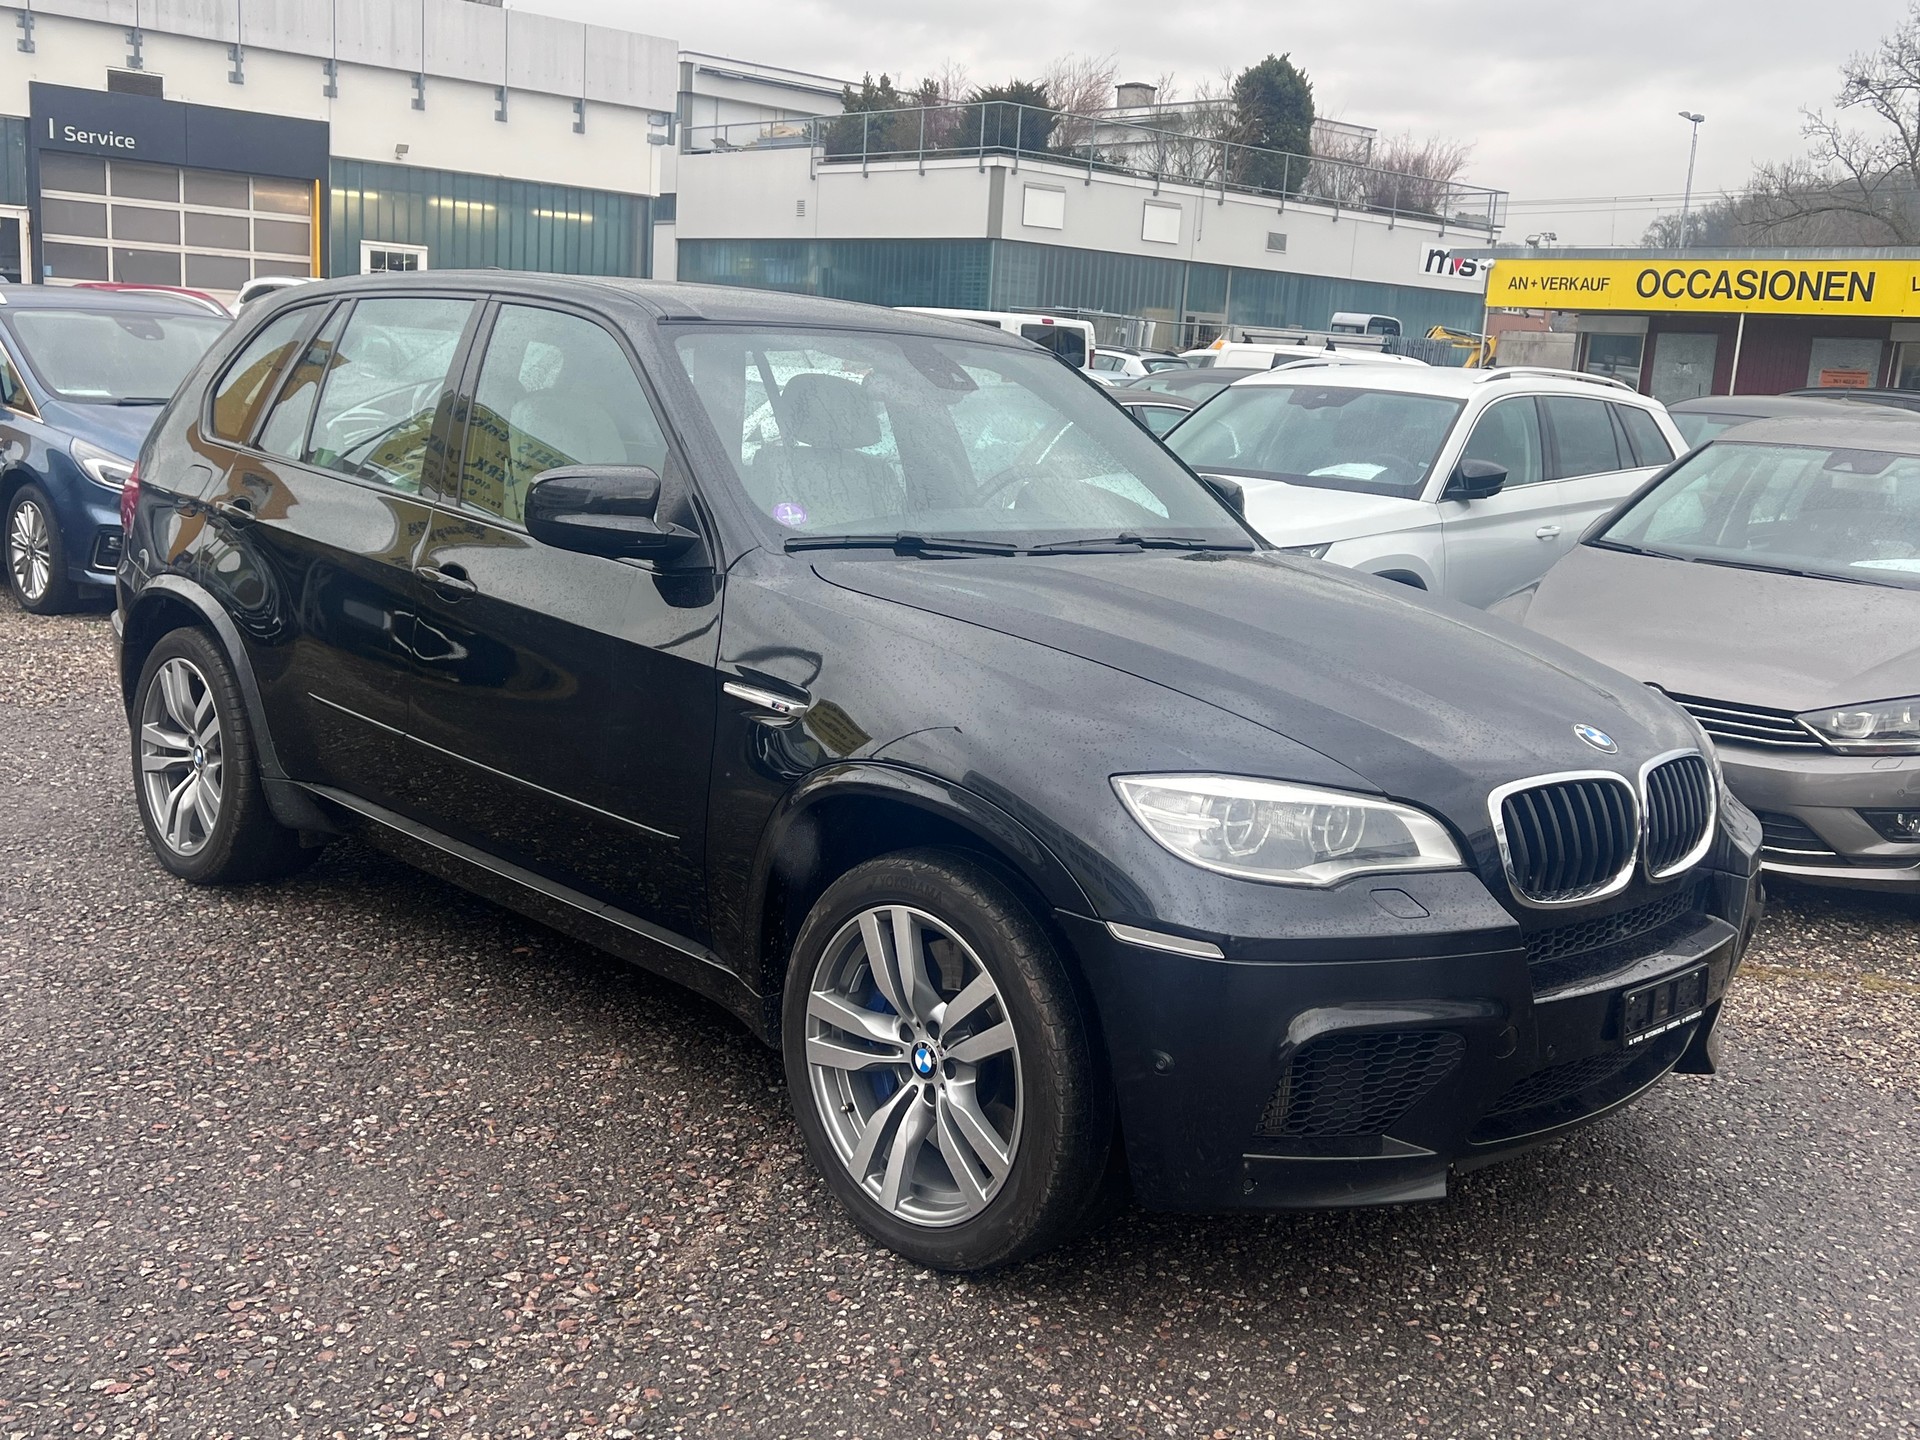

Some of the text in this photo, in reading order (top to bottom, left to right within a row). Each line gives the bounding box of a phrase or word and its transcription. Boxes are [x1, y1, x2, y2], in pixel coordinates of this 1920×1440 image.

[64, 125, 135, 149] Service
[1540, 276, 1611, 292] VERKAUF
[1636, 268, 1876, 302] OCCASIONEN
[879, 874, 944, 905] YOKOHAMA
